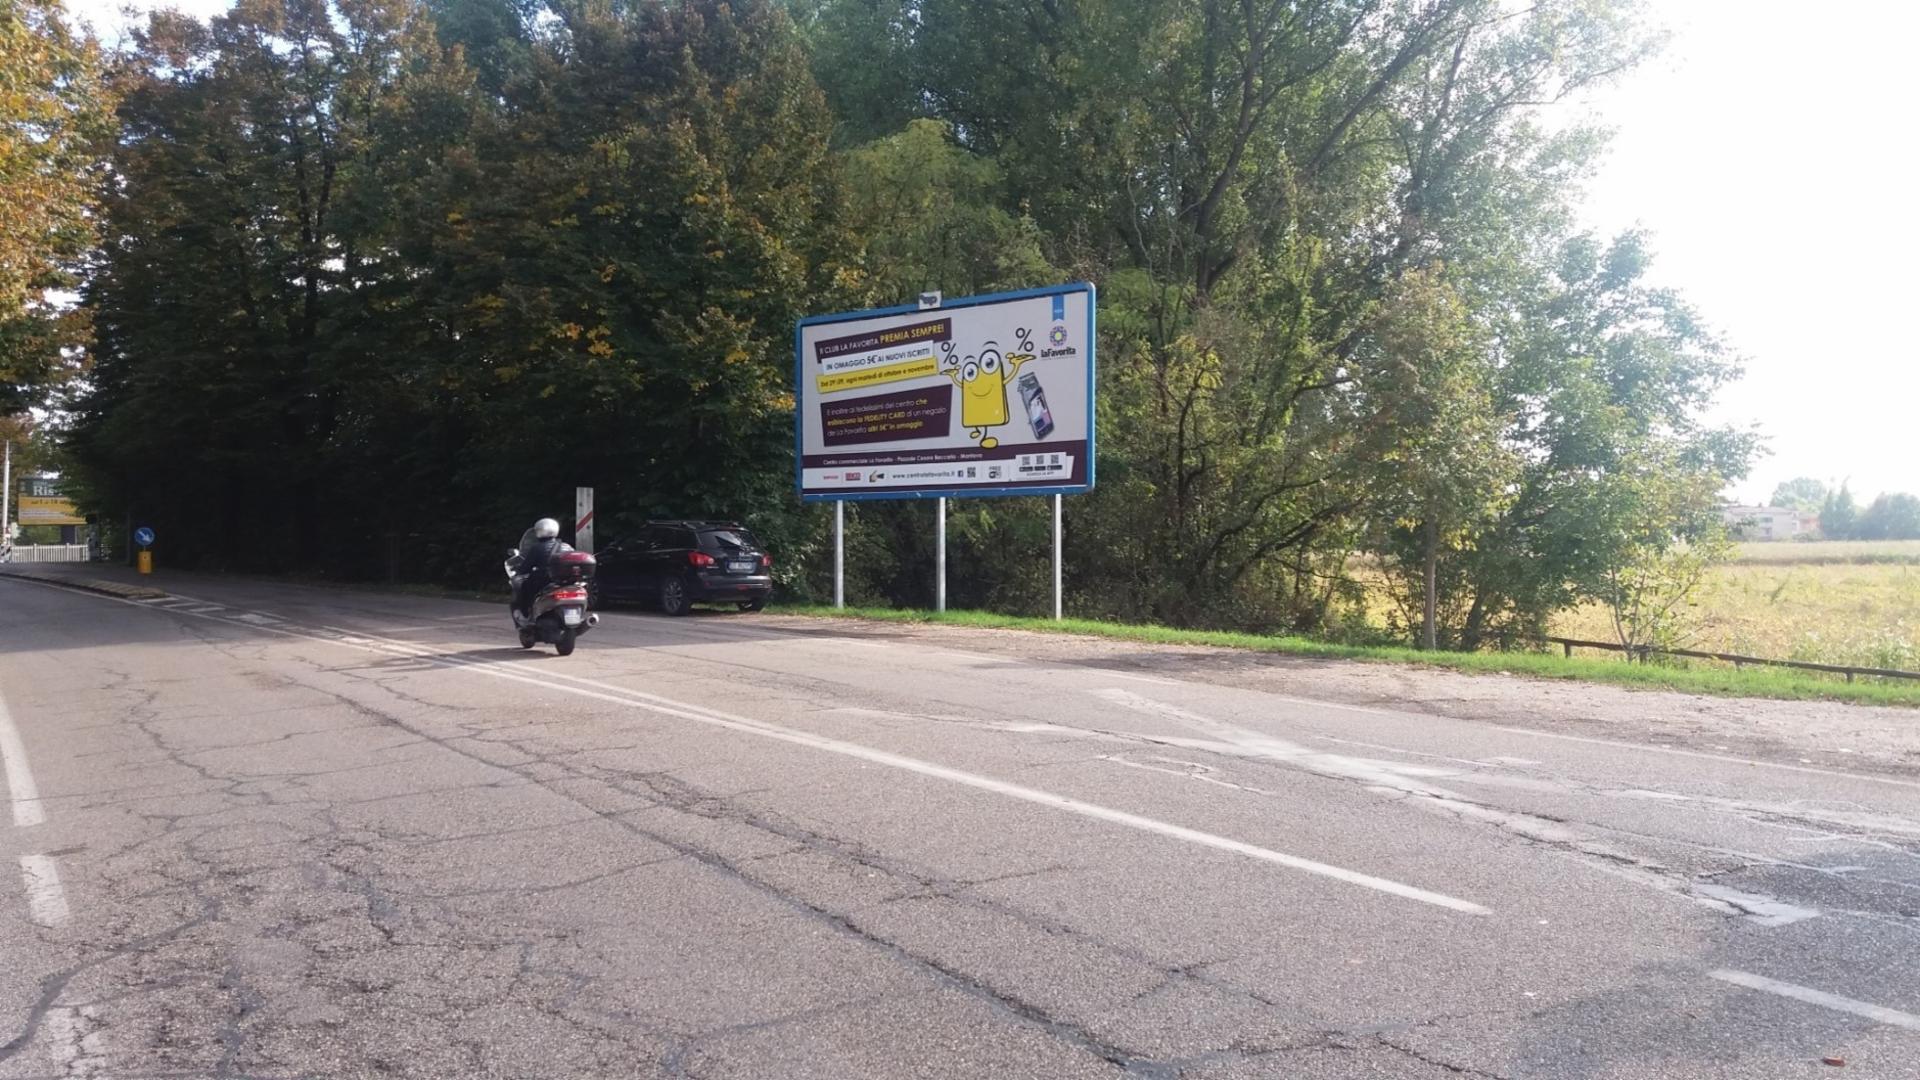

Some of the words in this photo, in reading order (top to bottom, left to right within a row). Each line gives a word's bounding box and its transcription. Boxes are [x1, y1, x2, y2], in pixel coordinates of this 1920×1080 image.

[824, 344, 840, 354] CLUB
[840, 343, 848, 351] LA
[849, 338, 879, 350] FAVORITA
[880, 330, 910, 344] PREMIA
[911, 322, 945, 338] SEMPRE!
[1015, 327, 1034, 352] %
[833, 358, 866, 369] OMAGGIO
[885, 351, 906, 361] NUOVI
[941, 341, 959, 365] %
[907, 363, 935, 373] novembre
[895, 400, 915, 408] centro
[915, 398, 928, 406] che
[888, 411, 905, 420] CARD
[921, 406, 947, 416] negozio
[896, 420, 924, 430] omaggio
